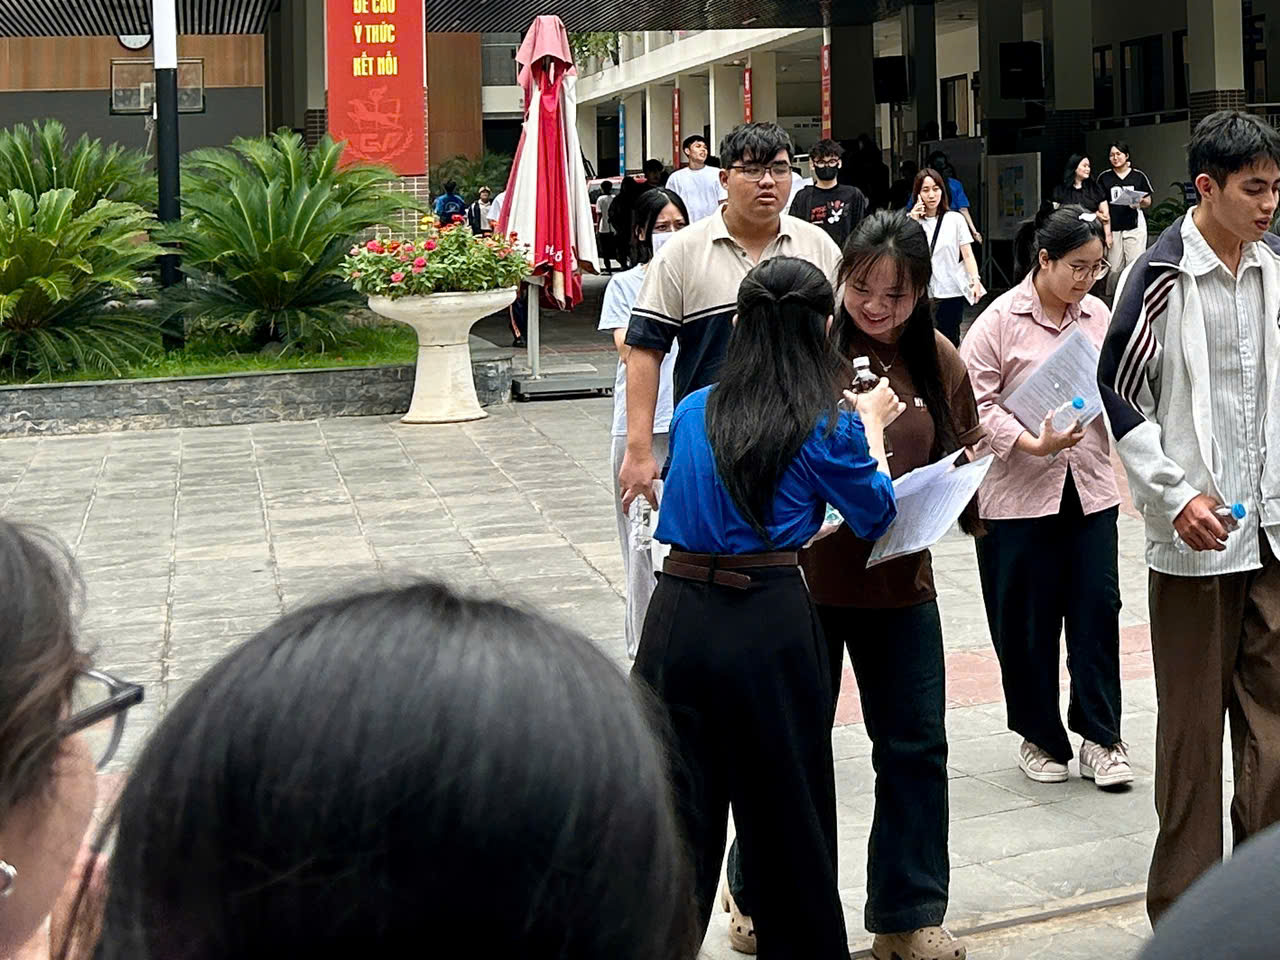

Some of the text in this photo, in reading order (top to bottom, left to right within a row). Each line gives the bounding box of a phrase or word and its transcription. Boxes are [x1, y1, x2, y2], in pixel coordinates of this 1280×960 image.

[354, 22, 396, 44] Ý THỨC
[353, 51, 398, 76] KẾT NỐI
